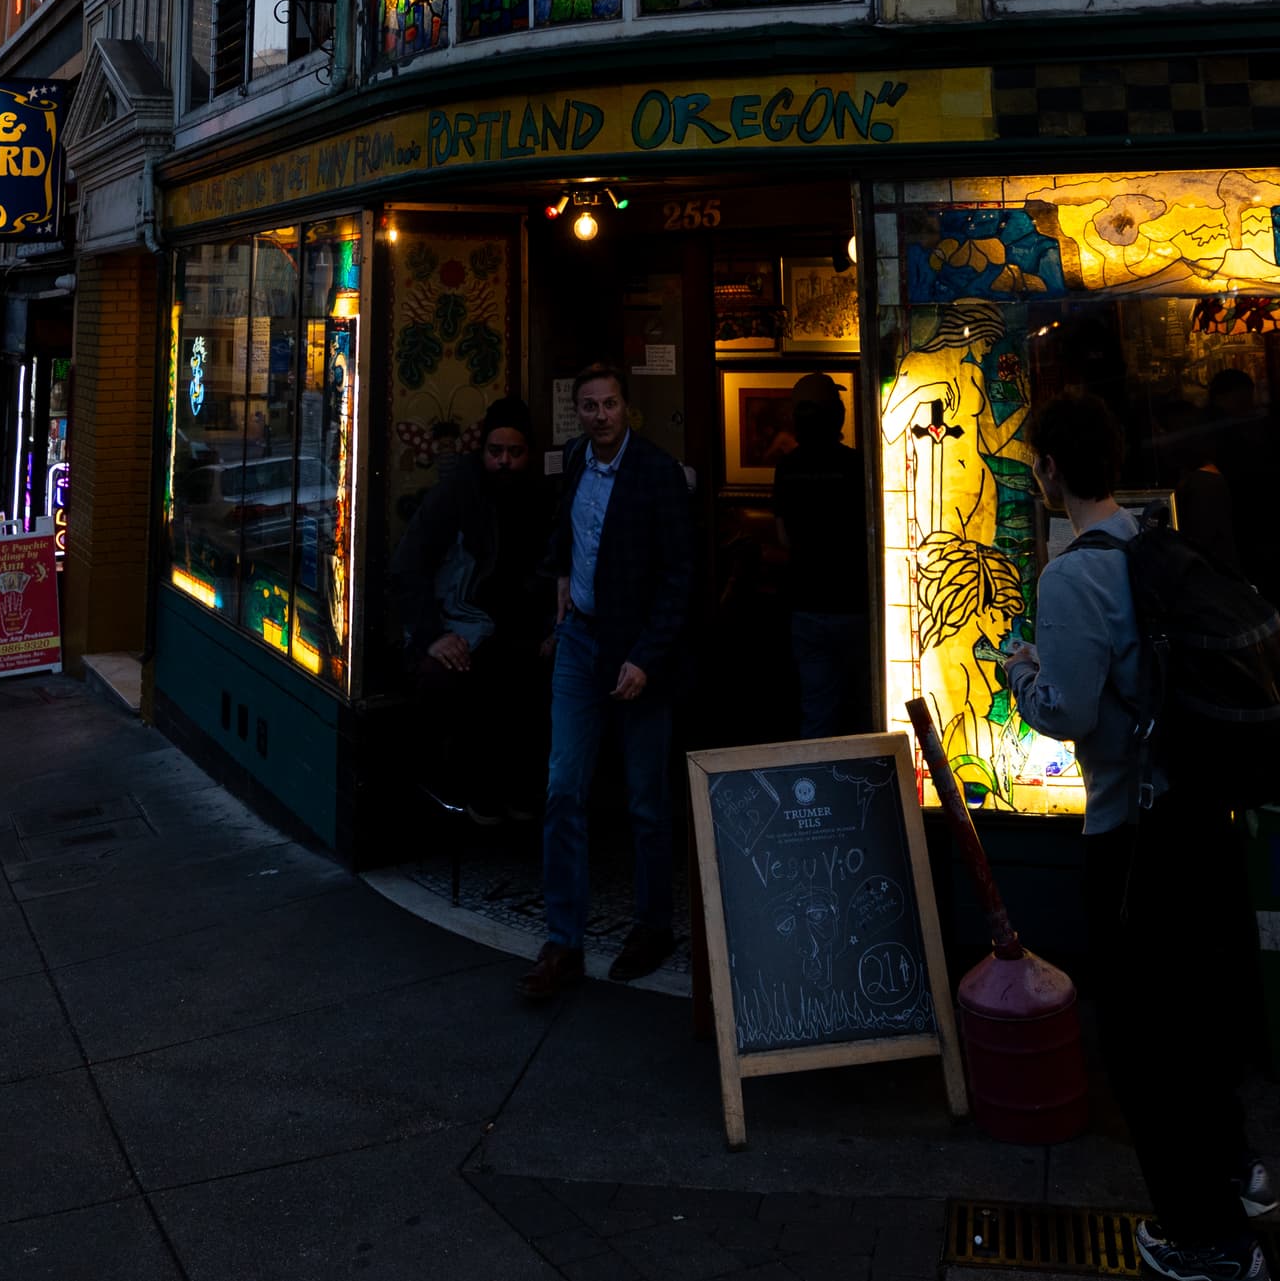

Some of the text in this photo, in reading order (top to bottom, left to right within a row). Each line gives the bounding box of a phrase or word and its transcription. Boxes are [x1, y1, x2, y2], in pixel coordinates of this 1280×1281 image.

[426, 99, 605, 168] PORTLAND
[662, 199, 722, 230] 255
[12, 540, 49, 553] Psychic
[0, 561, 25, 573] Ann
[783, 806, 833, 820] TRUMER
[797, 817, 822, 830] PILS
